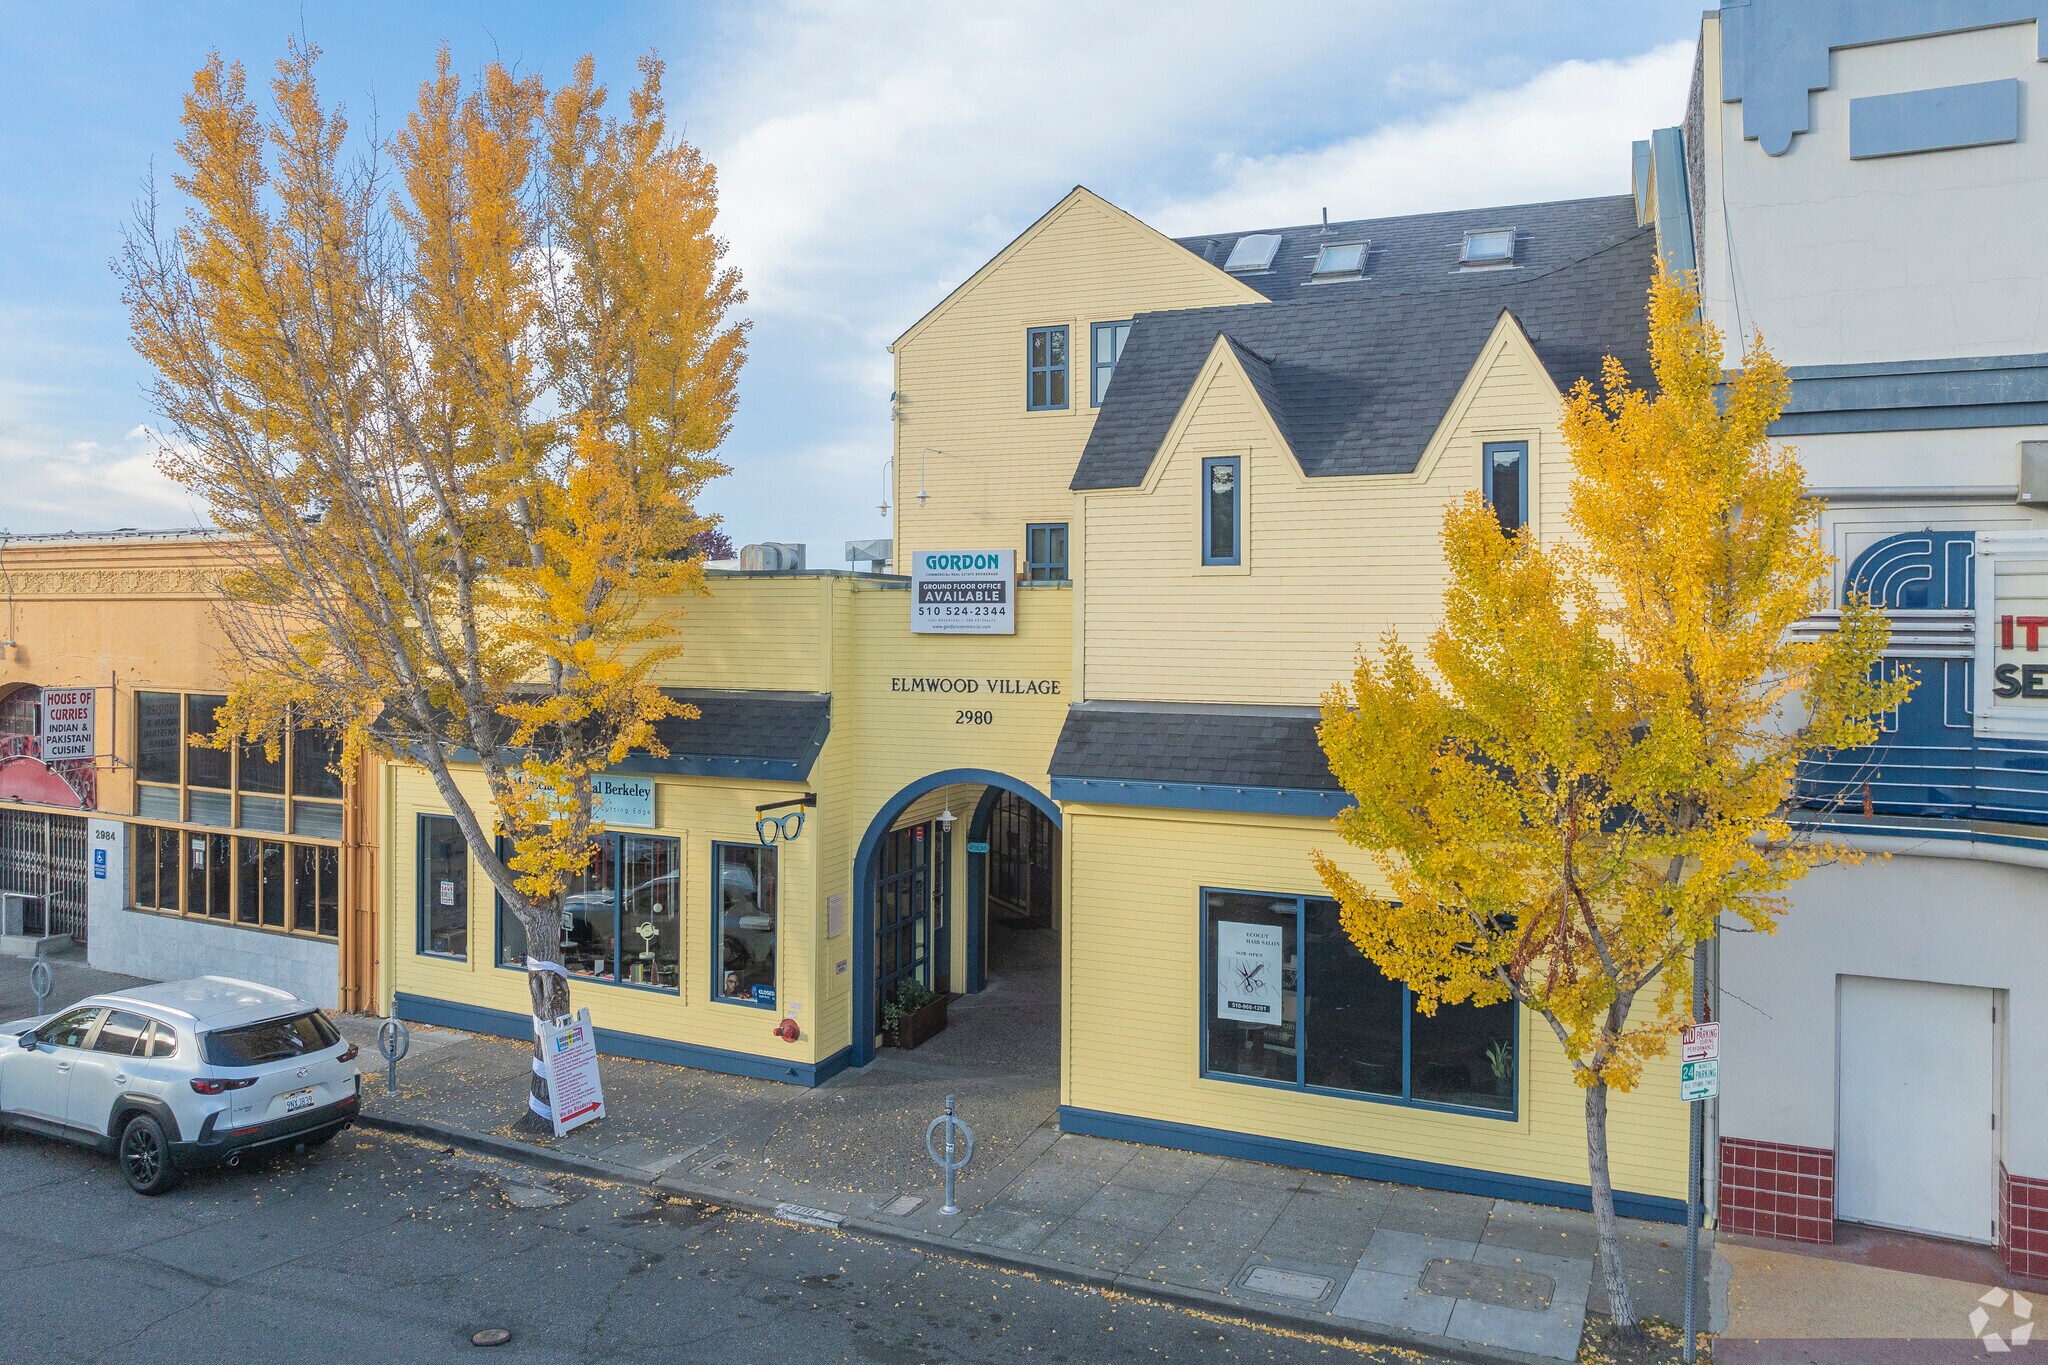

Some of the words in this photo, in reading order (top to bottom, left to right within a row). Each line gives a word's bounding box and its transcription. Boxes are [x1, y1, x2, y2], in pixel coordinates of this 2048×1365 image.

[926, 554, 998, 571] GORDON
[925, 591, 1000, 601] AVAILABLE
[918, 607, 940, 616] 510
[946, 607, 1006, 615] 524-2344
[892, 678, 979, 693] ELMWOOD
[986, 679, 1061, 694] VILLAGE
[47, 693, 76, 706] HOUSE
[80, 692, 91, 705] OF
[50, 708, 88, 721] CURRIES
[956, 710, 993, 725] 2980
[49, 724, 78, 733] INDIAN
[82, 723, 88, 731] &
[46, 734, 91, 744] PAKISTANI
[52, 745, 86, 755] CUISINE
[605, 782, 651, 801] Berkeley
[633, 808, 651, 816] Edge
[96, 830, 115, 841] 2984
[1696, 1028, 1717, 1040] PARKING
[1687, 1044, 1715, 1052] PERFORMANCE
[1683, 1066, 1694, 1079] 24
[1696, 1068, 1716, 1080] PARKING
